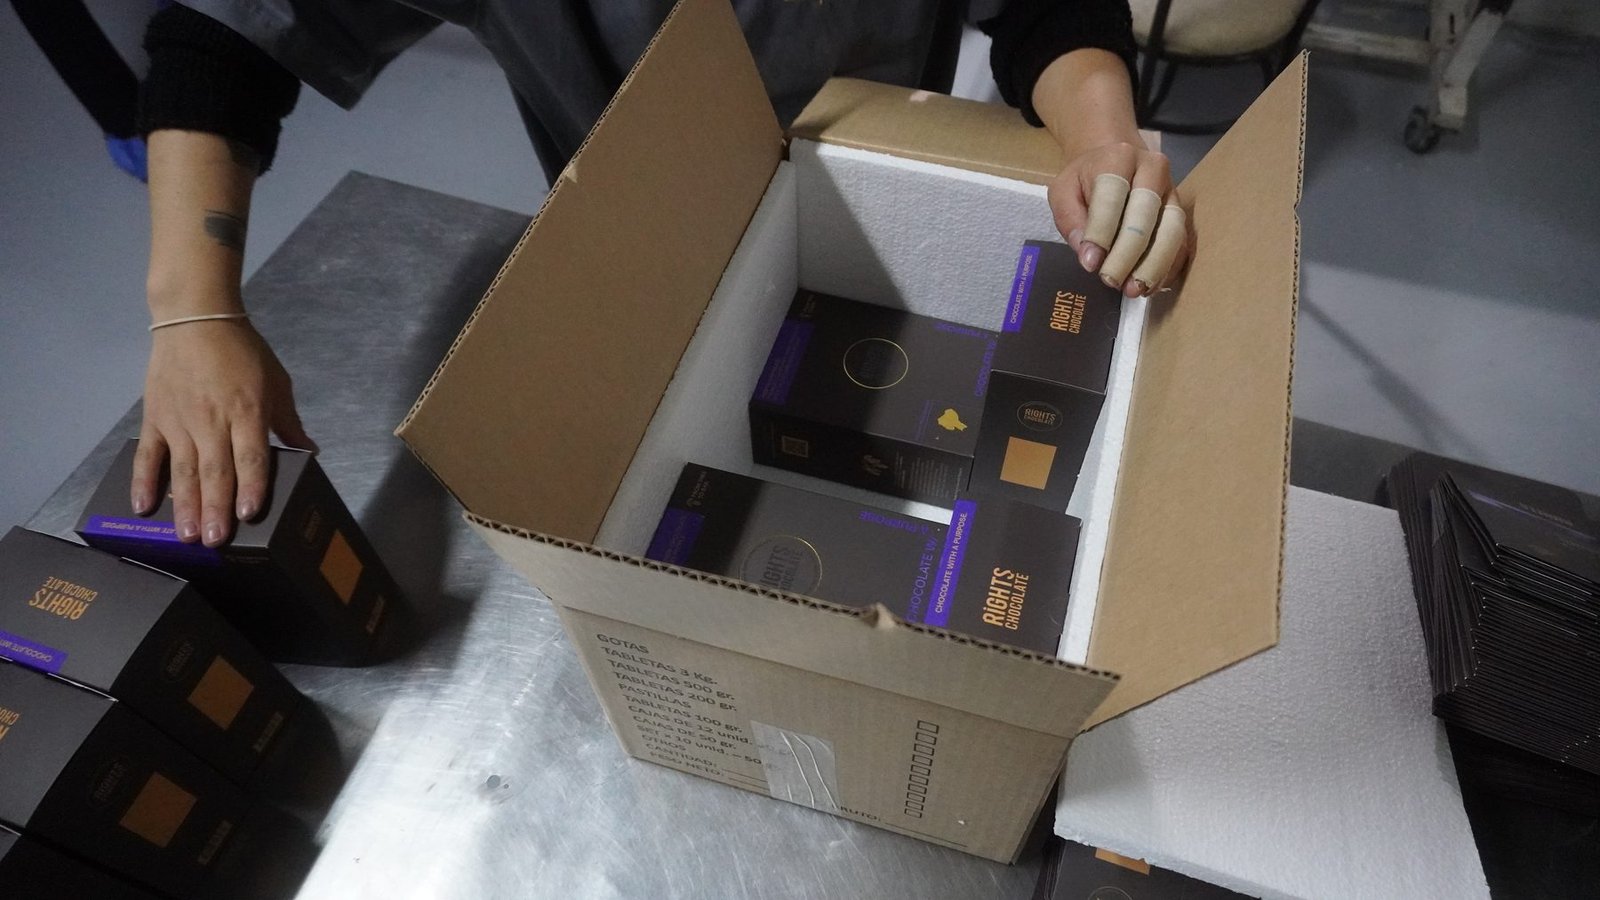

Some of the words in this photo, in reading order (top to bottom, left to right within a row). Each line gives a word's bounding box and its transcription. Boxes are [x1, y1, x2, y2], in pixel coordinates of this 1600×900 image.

[1069, 294, 1086, 334] CHOCOLATE
[934, 570, 953, 613] CHOCOLATE
[946, 551, 958, 570] WITH
[954, 512, 967, 544] PURPOSE
[43, 576, 98, 602] CHOCOLATE
[905, 553, 934, 622] CHOCOLATE
[1005, 572, 1029, 630] CHOCOLATE
[597, 633, 649, 654] GOTAS
[600, 646, 676, 673] TABLETAS
[680, 667, 689, 677] 3
[607, 659, 680, 685] TABLETAS
[683, 680, 712, 693] 500
[716, 690, 735, 700] gr.
[613, 671, 684, 697] TABLETAS
[687, 692, 715, 705] 200
[719, 702, 737, 711] gr.
[618, 683, 691, 709] PASTILLAS
[0, 707, 20, 726] CHO
[622, 694, 691, 718] TABLETAS
[695, 714, 721, 726] 100
[725, 723, 743, 733] gr.
[628, 705, 670, 721] CAJAS
[674, 718, 693, 727] DE
[697, 724, 713, 735] 12
[717, 731, 753, 746] unid.
[633, 715, 674, 731] CAJAS
[677, 727, 696, 738] DE
[698, 733, 717, 744] 50
[641, 734, 686, 751] OTROS
[675, 735, 691, 745] 10
[694, 742, 729, 756] unid.
[744, 755, 762, 765] 50
[839, 805, 881, 821] RUTO:
